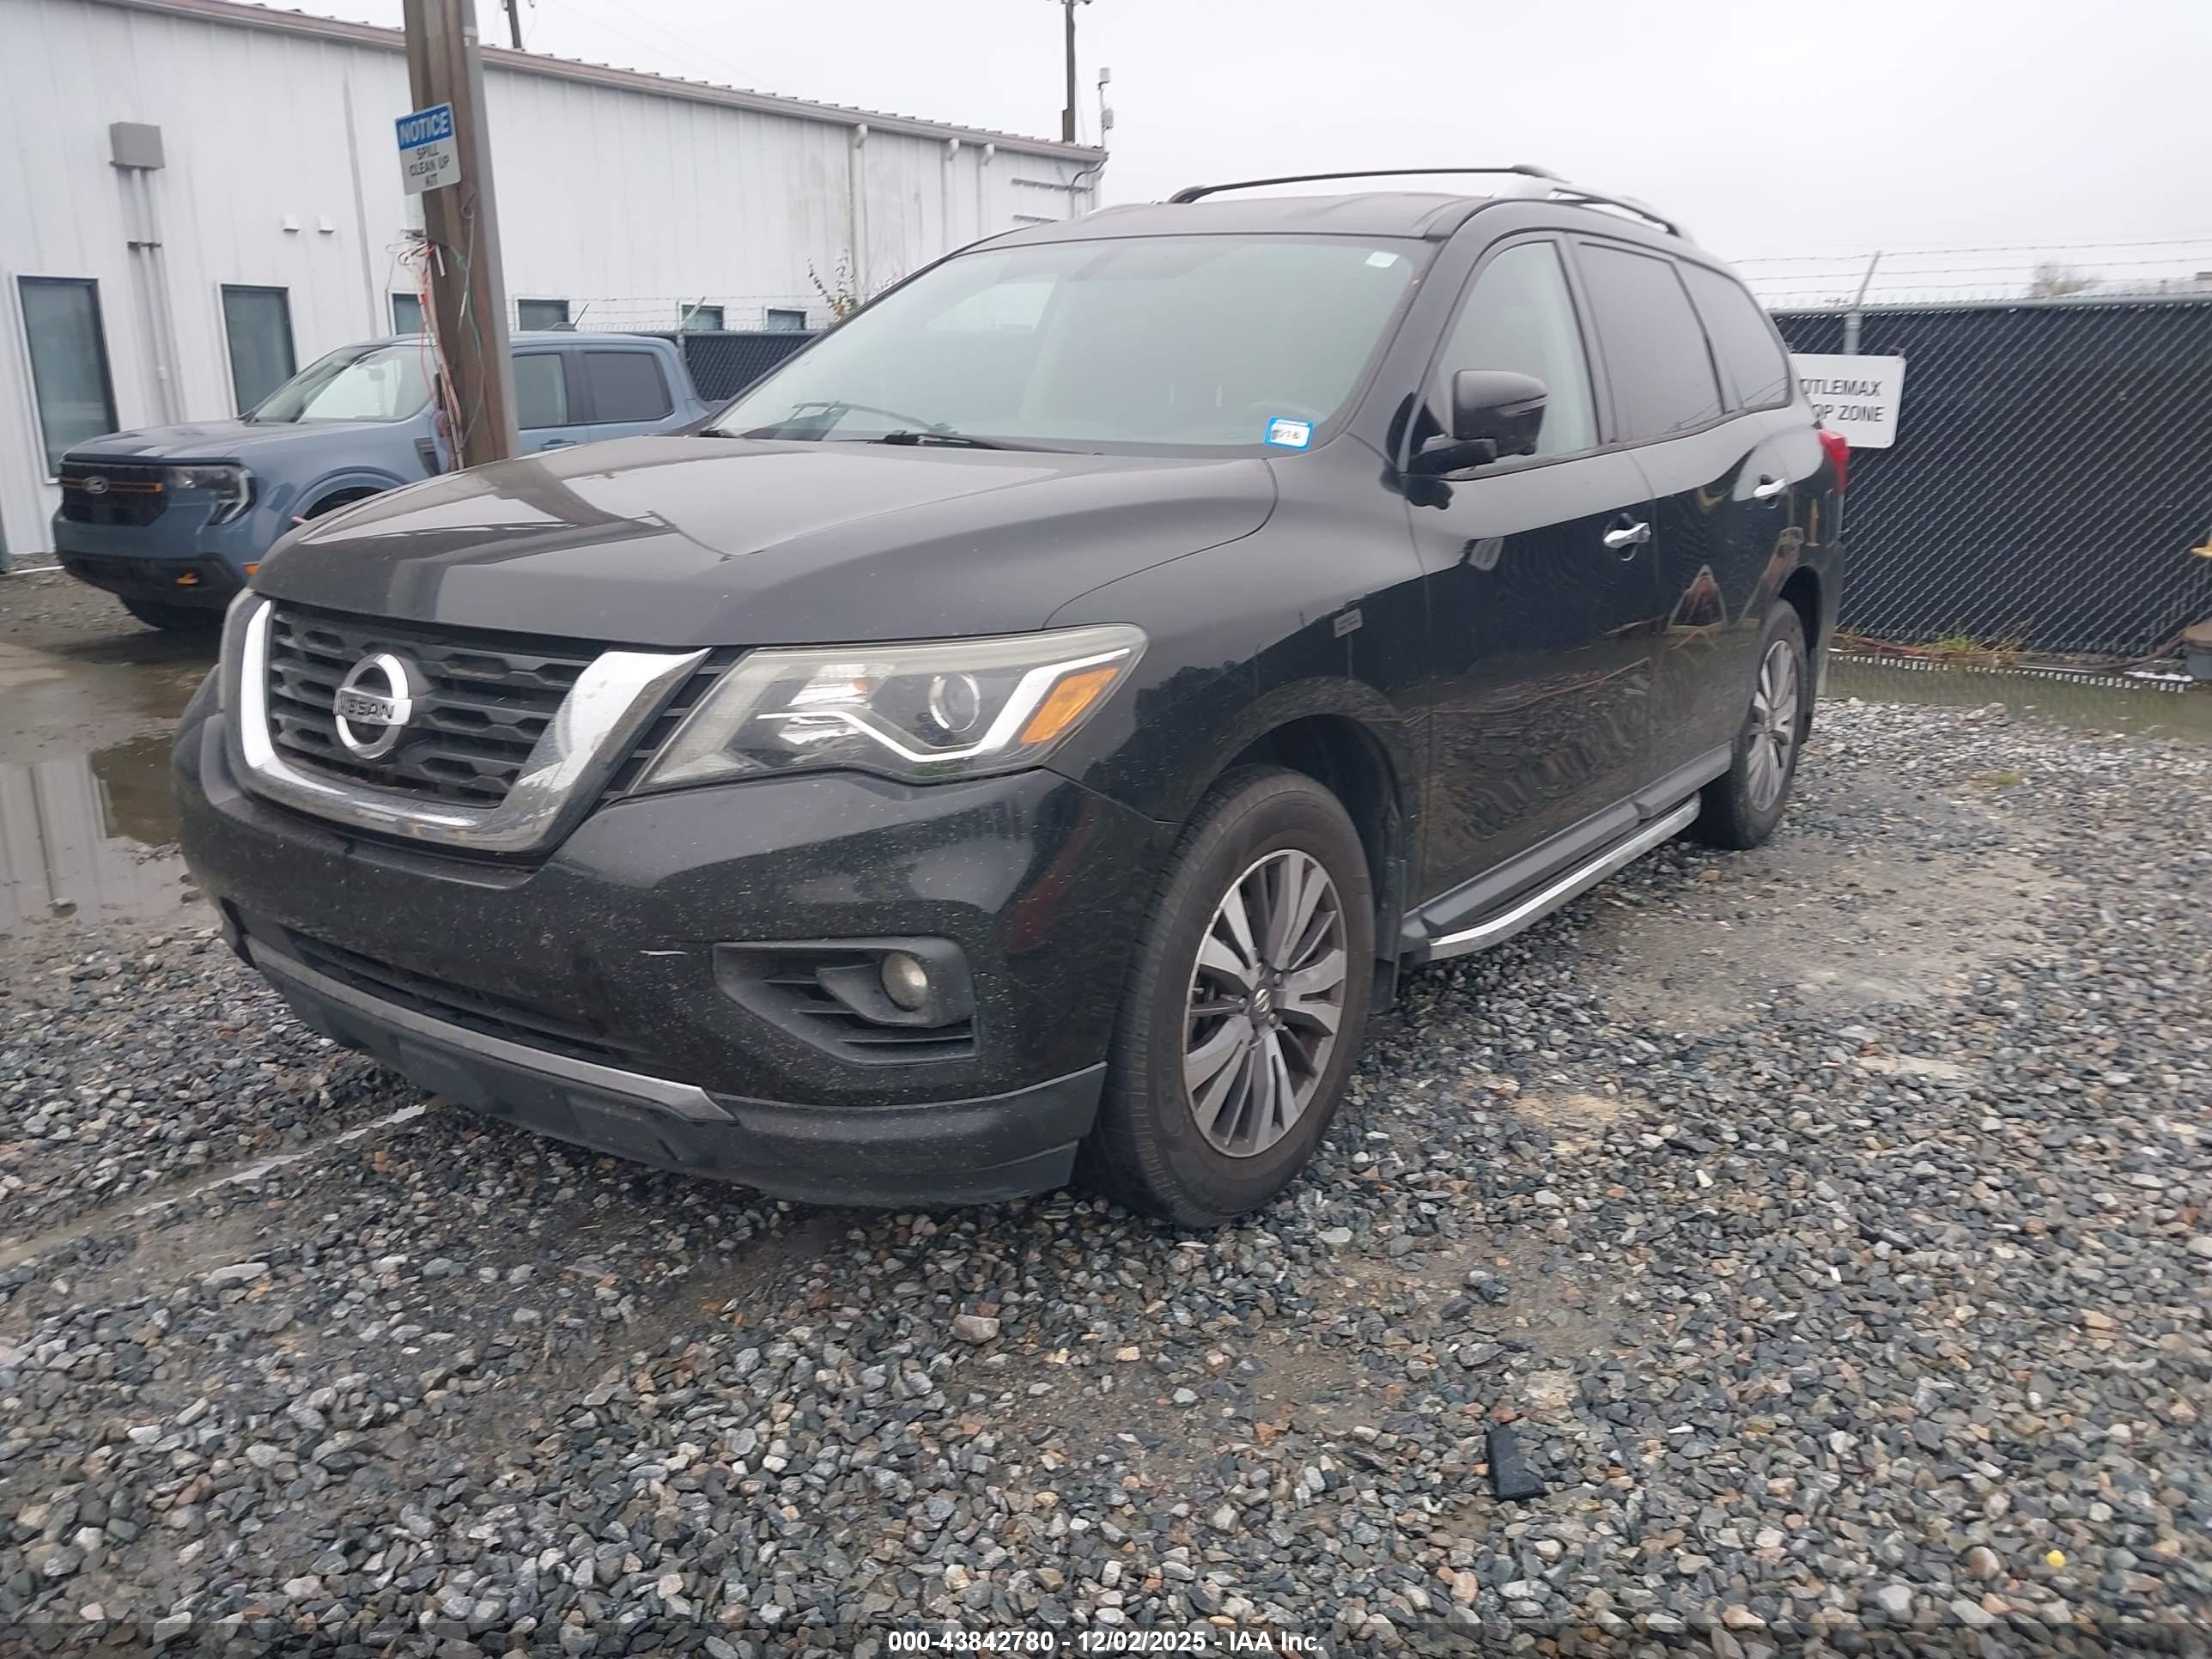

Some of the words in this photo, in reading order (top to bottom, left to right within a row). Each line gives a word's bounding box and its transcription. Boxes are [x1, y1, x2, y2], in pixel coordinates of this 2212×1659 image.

[398, 110, 450, 146] NOTICE
[437, 154, 450, 170] UP
[1838, 404, 1886, 422] ZONE
[336, 696, 395, 720] NISSAN
